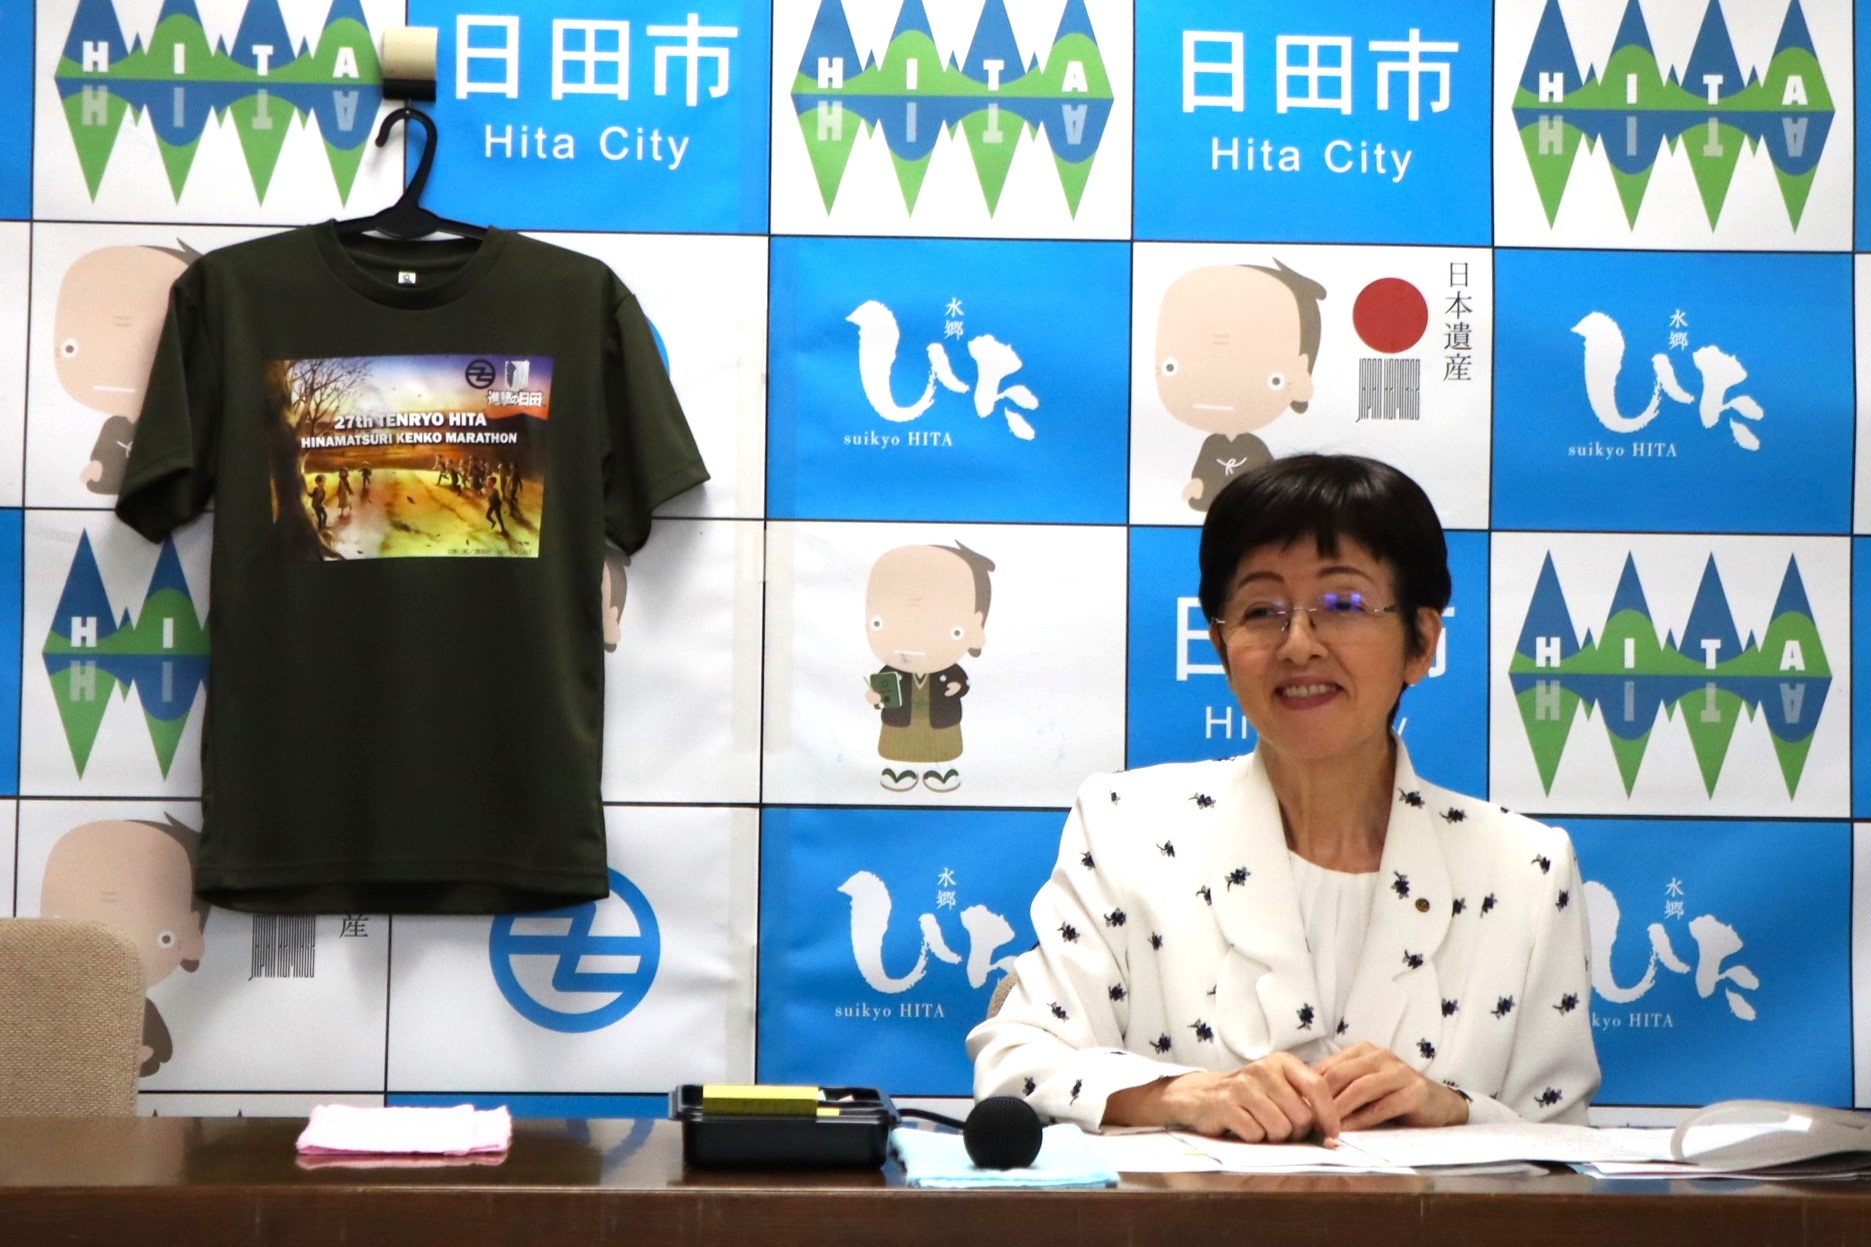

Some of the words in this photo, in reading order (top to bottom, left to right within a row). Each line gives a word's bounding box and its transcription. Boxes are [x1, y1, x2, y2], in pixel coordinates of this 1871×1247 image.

[82, 41, 360, 79] HITA
[455, 13, 739, 107] 日田市
[817, 57, 1088, 93] HITA
[1182, 29, 1460, 122] 日田市
[1538, 72, 1809, 106] HITA
[485, 124, 575, 160] Hita
[600, 126, 689, 170] City
[1212, 137, 1300, 173] Hita
[1324, 139, 1412, 183] City
[944, 297, 965, 340] 水郷
[1443, 261, 1473, 382] 日本遺産
[1669, 309, 1689, 351] 水郷
[334, 415, 374, 430] 27th
[377, 412, 444, 428] TENRYO
[448, 411, 487, 427] HITA
[300, 432, 393, 449] HINAMATSURI
[396, 432, 442, 445] KENKO
[445, 432, 518, 444] MARATHON
[843, 430, 901, 450] suikyo
[907, 431, 953, 447] HITA
[1568, 442, 1625, 461] suikyo
[1632, 442, 1677, 457] HITA
[71, 616, 174, 649] HI
[1535, 636, 1805, 672] HITA
[936, 867, 957, 910] 水郷
[1664, 877, 1685, 920] 水郷
[834, 1002, 892, 1021] suikyo
[899, 1003, 944, 1018] HITA
[1629, 1013, 1673, 1028] HITA
